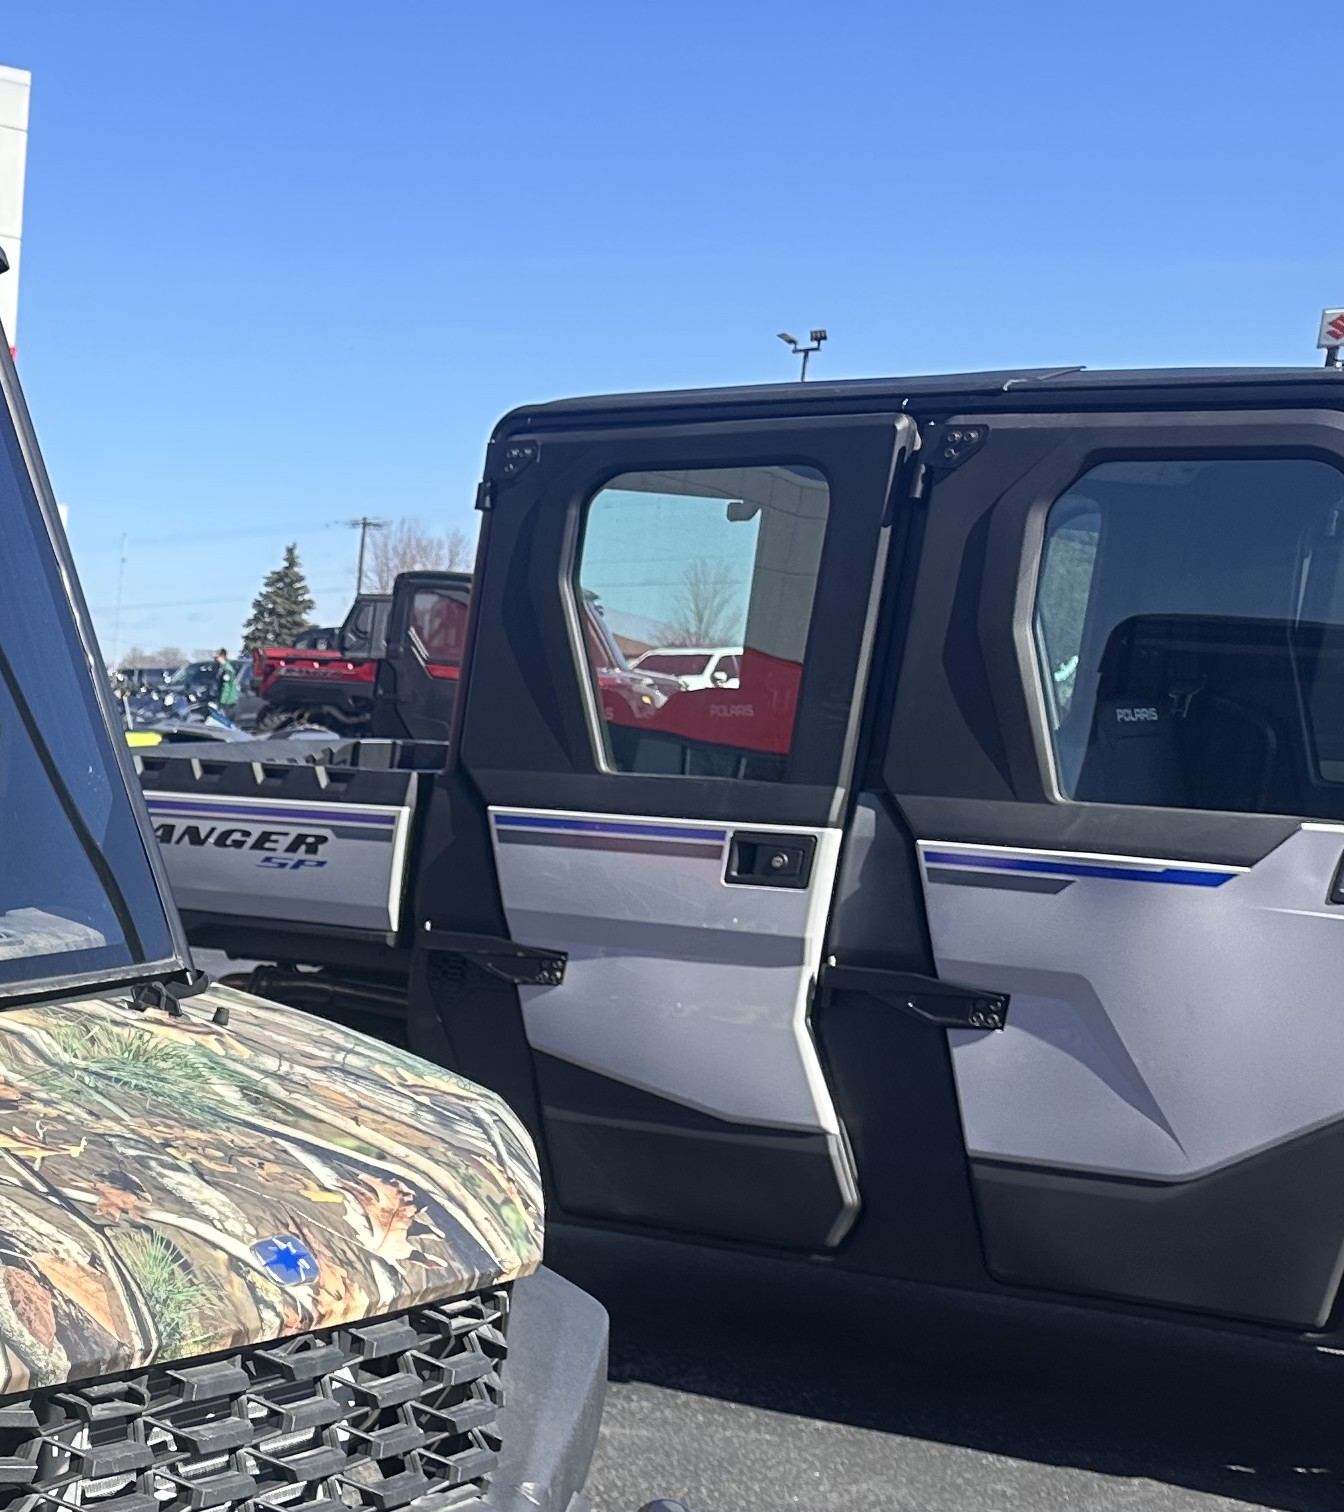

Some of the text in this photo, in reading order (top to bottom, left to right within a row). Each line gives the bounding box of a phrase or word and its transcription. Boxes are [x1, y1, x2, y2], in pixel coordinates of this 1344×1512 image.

[709, 704, 754, 717] POLARIS
[1116, 707, 1159, 722] POLARIS
[256, 855, 328, 870] SP
